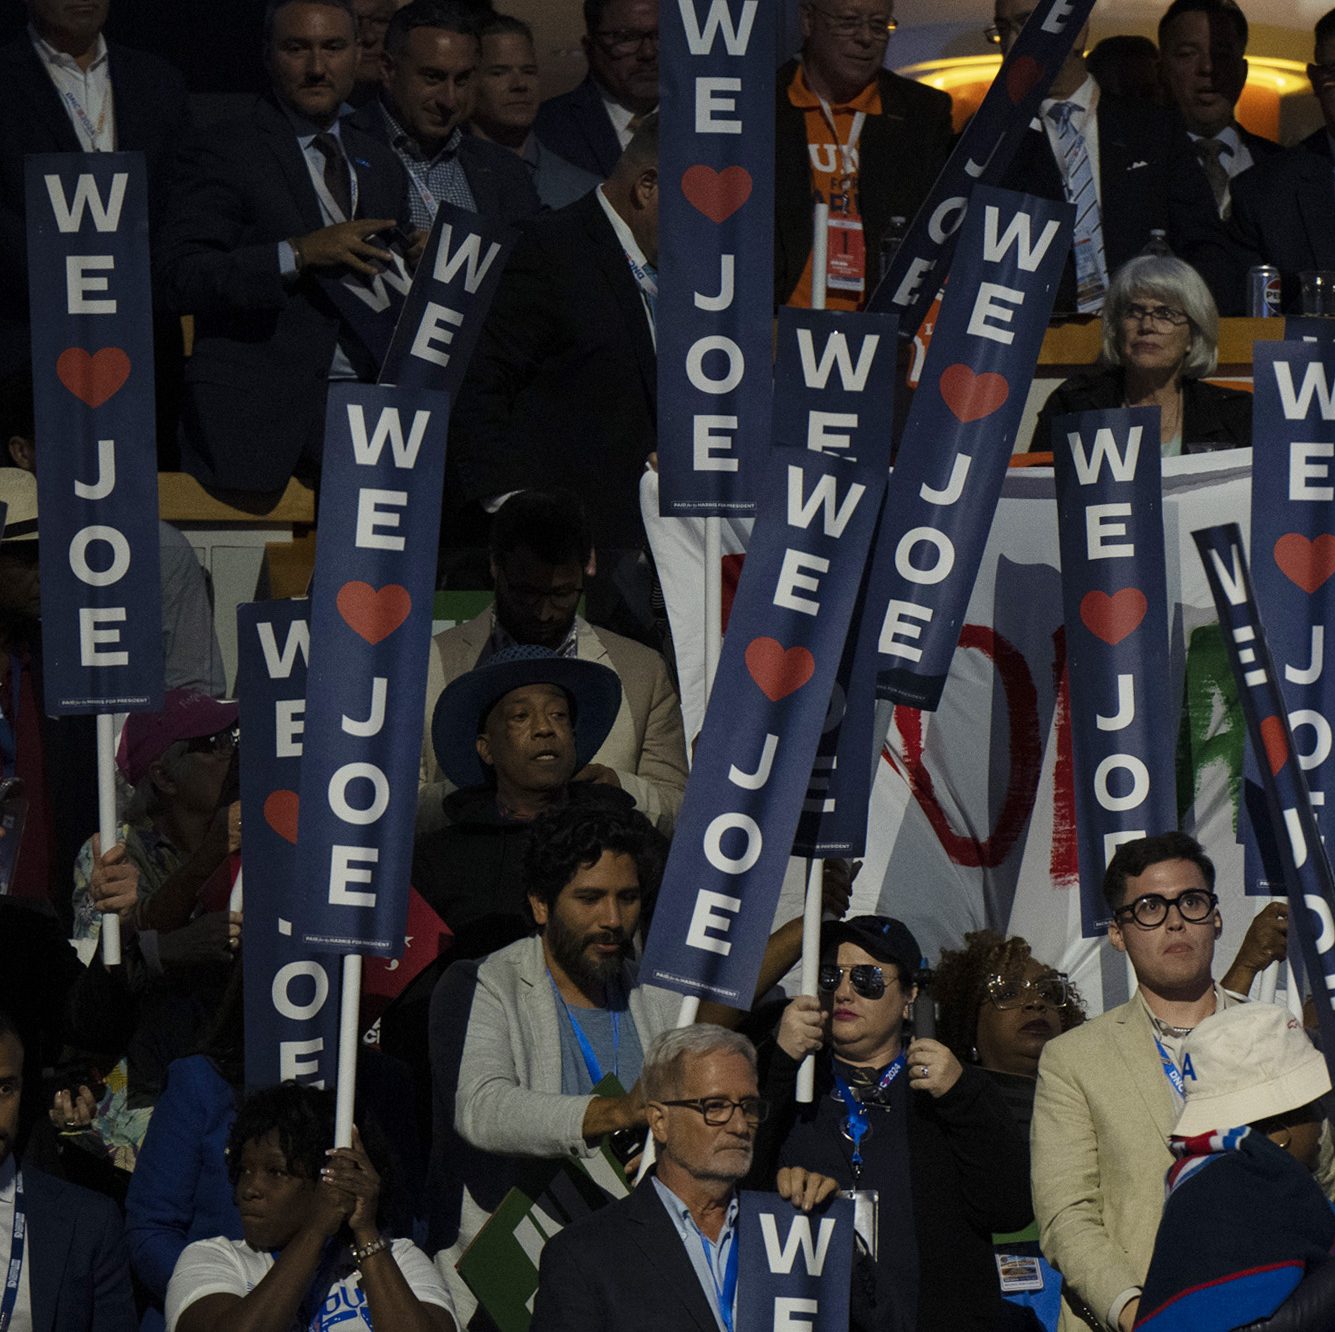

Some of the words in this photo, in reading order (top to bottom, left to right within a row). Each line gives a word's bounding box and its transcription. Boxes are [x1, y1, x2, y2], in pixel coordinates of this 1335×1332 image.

[681, 0, 758, 135] WE
[44, 173, 128, 314] WE
[410, 223, 501, 366] WE
[892, 131, 1005, 307] JOE
[966, 205, 1061, 345] WE
[685, 254, 745, 472] JOE
[796, 328, 881, 463] WE
[69, 440, 131, 666] JOE
[346, 404, 431, 551] WE
[773, 465, 866, 616] WE
[1067, 425, 1144, 560] WE
[877, 453, 972, 663] JOE
[328, 677, 390, 908] JOE
[1284, 625, 1334, 850] JO
[685, 734, 779, 956] JOE
[272, 919, 329, 1088] OE
